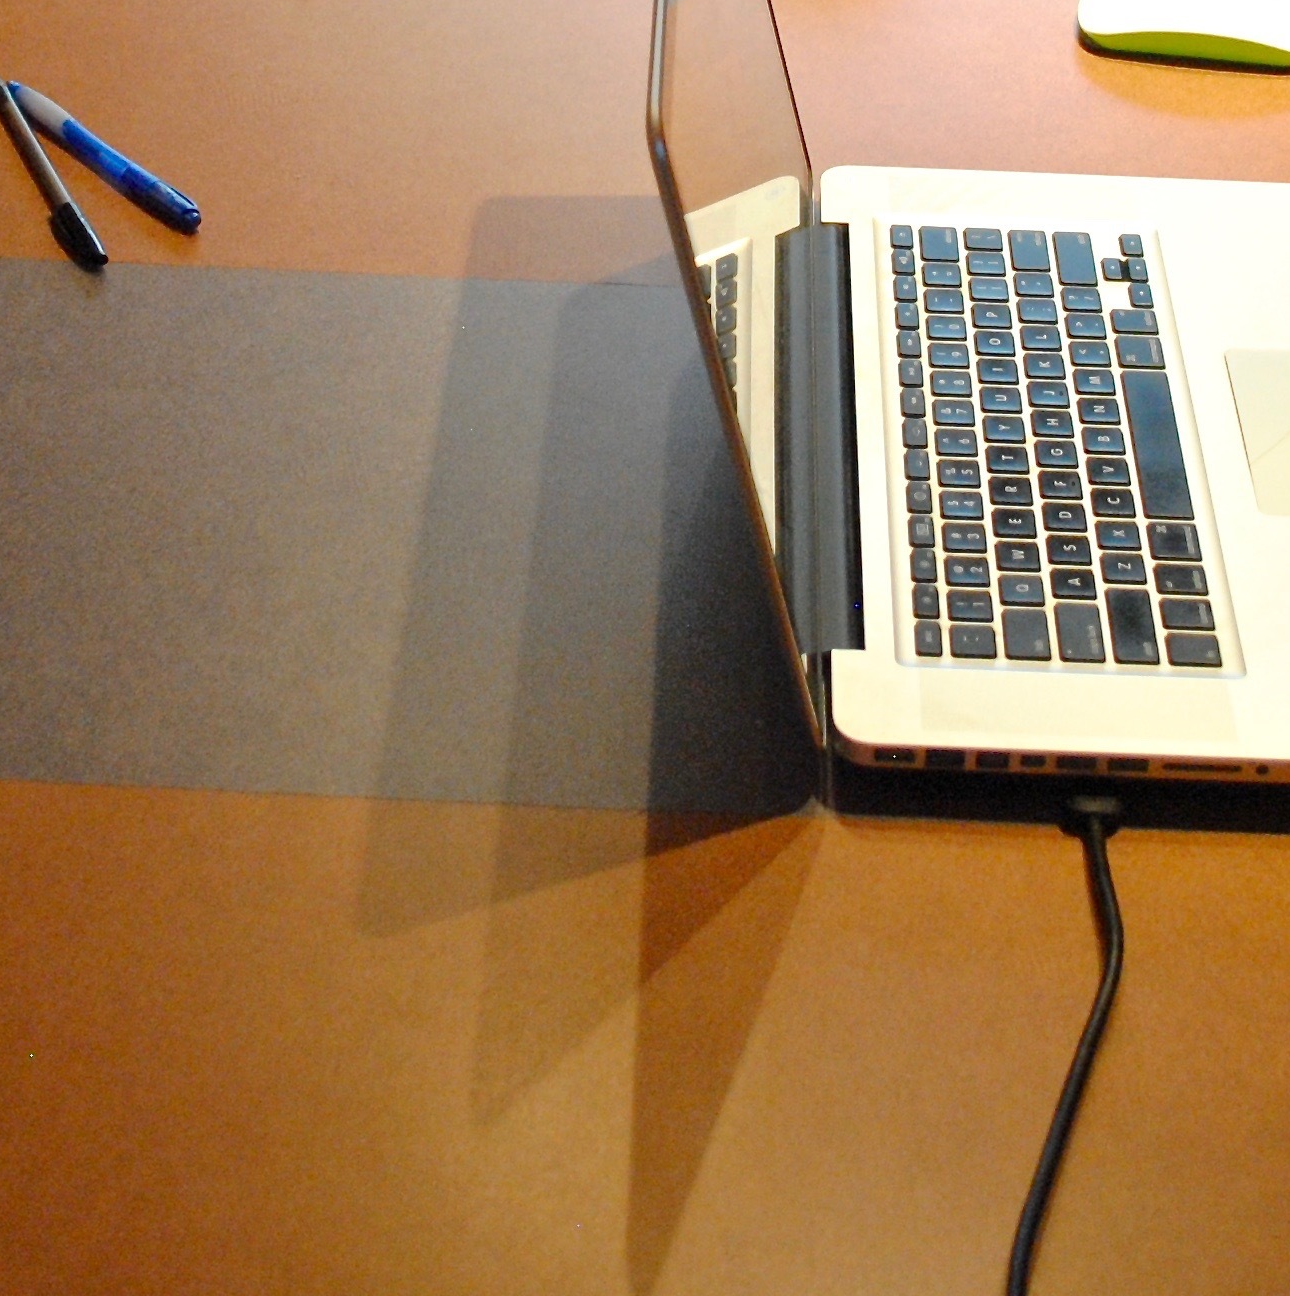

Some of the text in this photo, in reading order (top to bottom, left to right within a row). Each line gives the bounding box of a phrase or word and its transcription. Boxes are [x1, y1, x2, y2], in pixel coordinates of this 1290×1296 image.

[989, 337, 1001, 346] O
[1039, 360, 1050, 369] K
[995, 394, 1007, 402] U
[1046, 417, 1059, 427] H
[999, 423, 1010, 431] Y
[1051, 447, 1063, 457] G
[1089, 375, 1131, 571] Z X C V B N M
[1005, 485, 1017, 493] R
[1059, 510, 1072, 519] D
[1063, 544, 1076, 552] S
[1012, 548, 1024, 560] W
[1068, 577, 1081, 587] A
